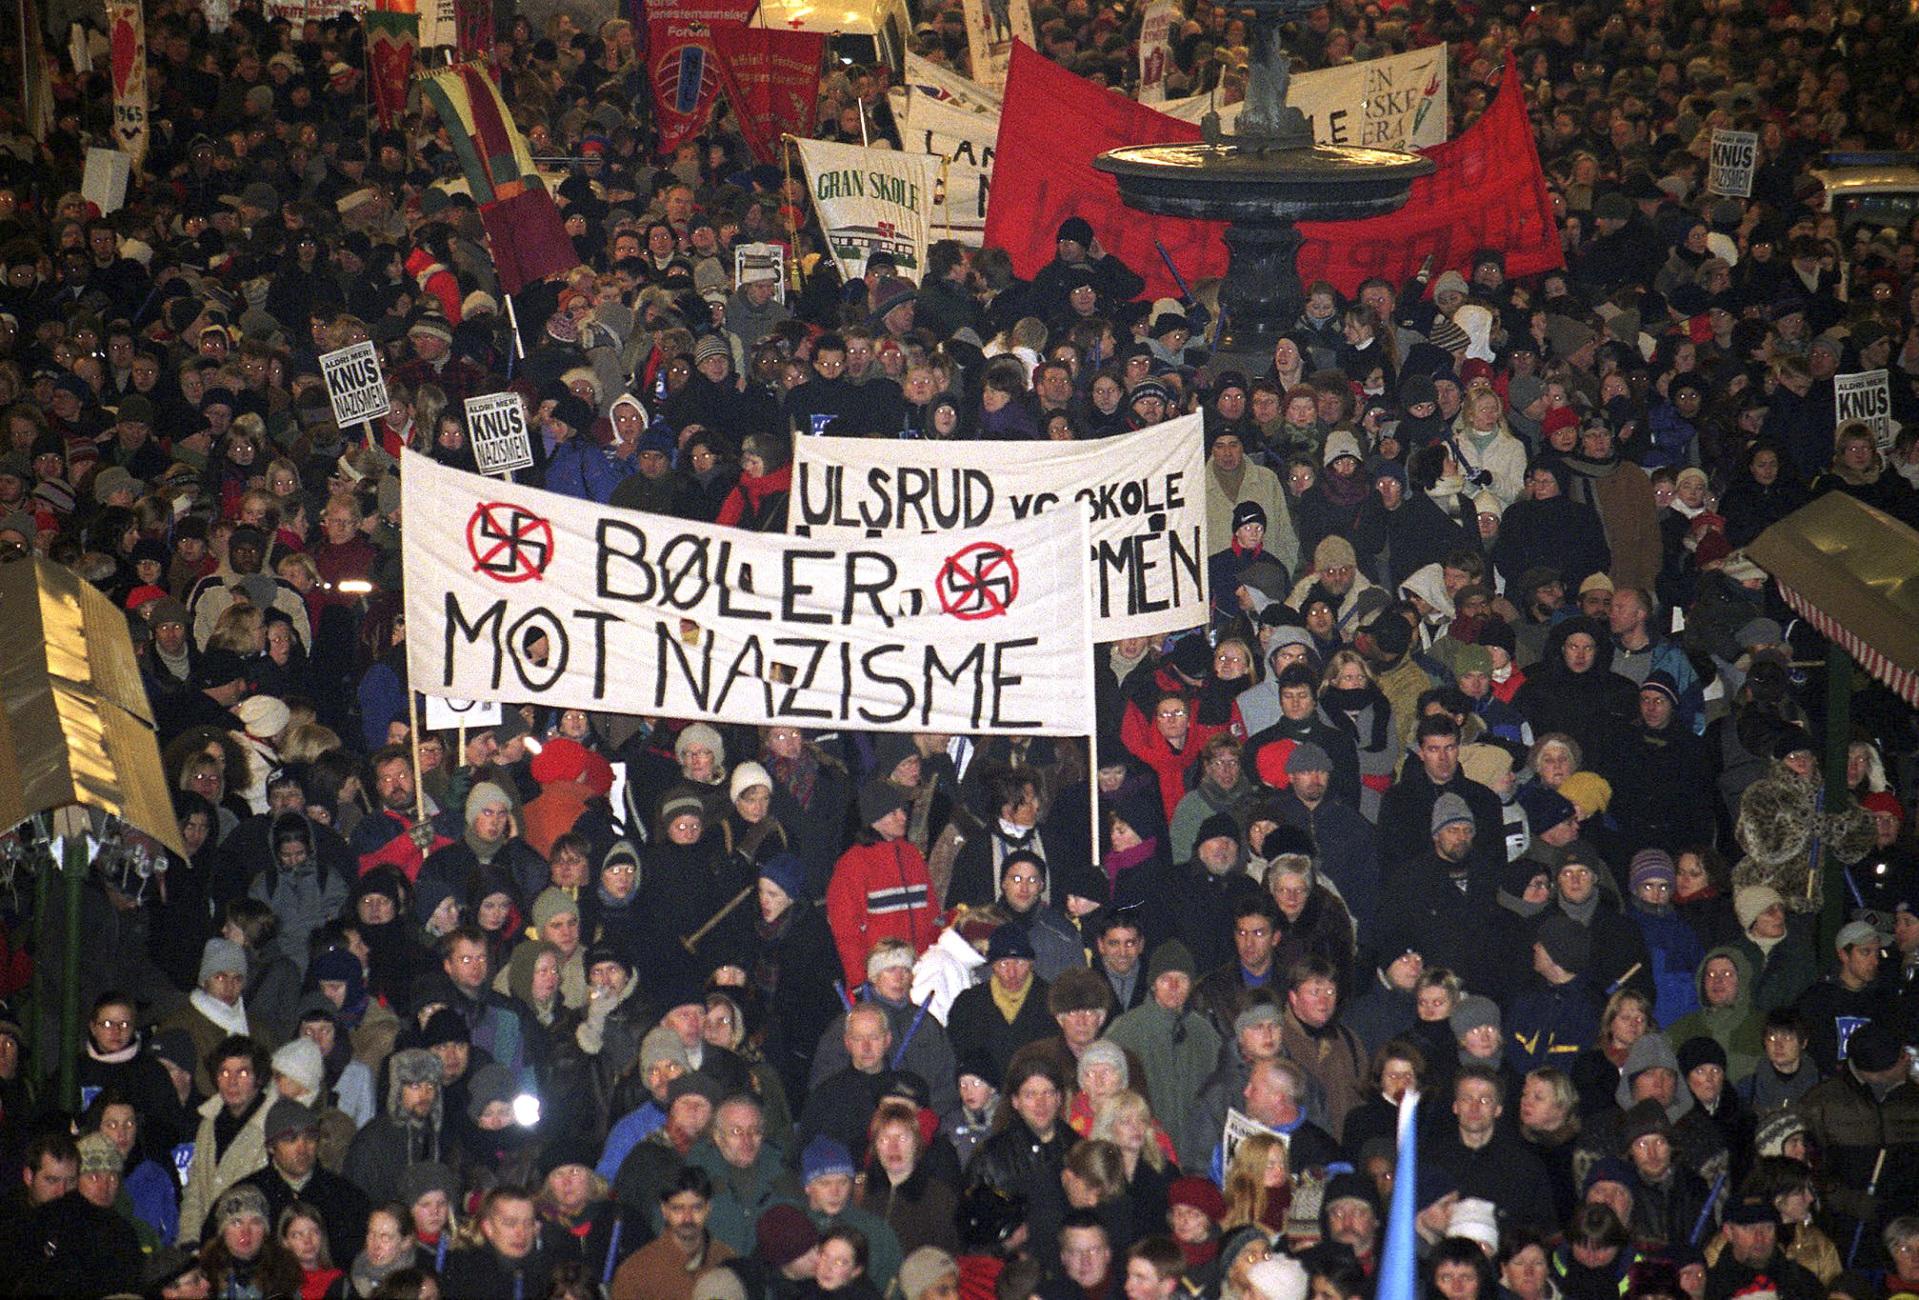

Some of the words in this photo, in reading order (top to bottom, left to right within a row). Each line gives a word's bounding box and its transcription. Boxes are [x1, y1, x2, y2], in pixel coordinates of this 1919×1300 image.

[1712, 142, 1753, 168] KNUS
[817, 169, 864, 201] GRAN
[868, 171, 920, 215] SKOLE
[325, 355, 350, 369] ALDRI
[350, 348, 372, 361] MER!
[326, 357, 379, 396] KNUS
[334, 383, 388, 420] NAZISMEN
[469, 402, 494, 413] ALDRI
[1838, 386, 1889, 420] KNUS
[470, 407, 523, 442] KNUS
[476, 434, 530, 466] NAZISMEN
[799, 462, 994, 530] ULSRUD
[595, 517, 898, 629] BØLER
[1091, 525, 1203, 618] MEN
[443, 591, 626, 699] MOT
[653, 620, 1043, 730] NAZISME
